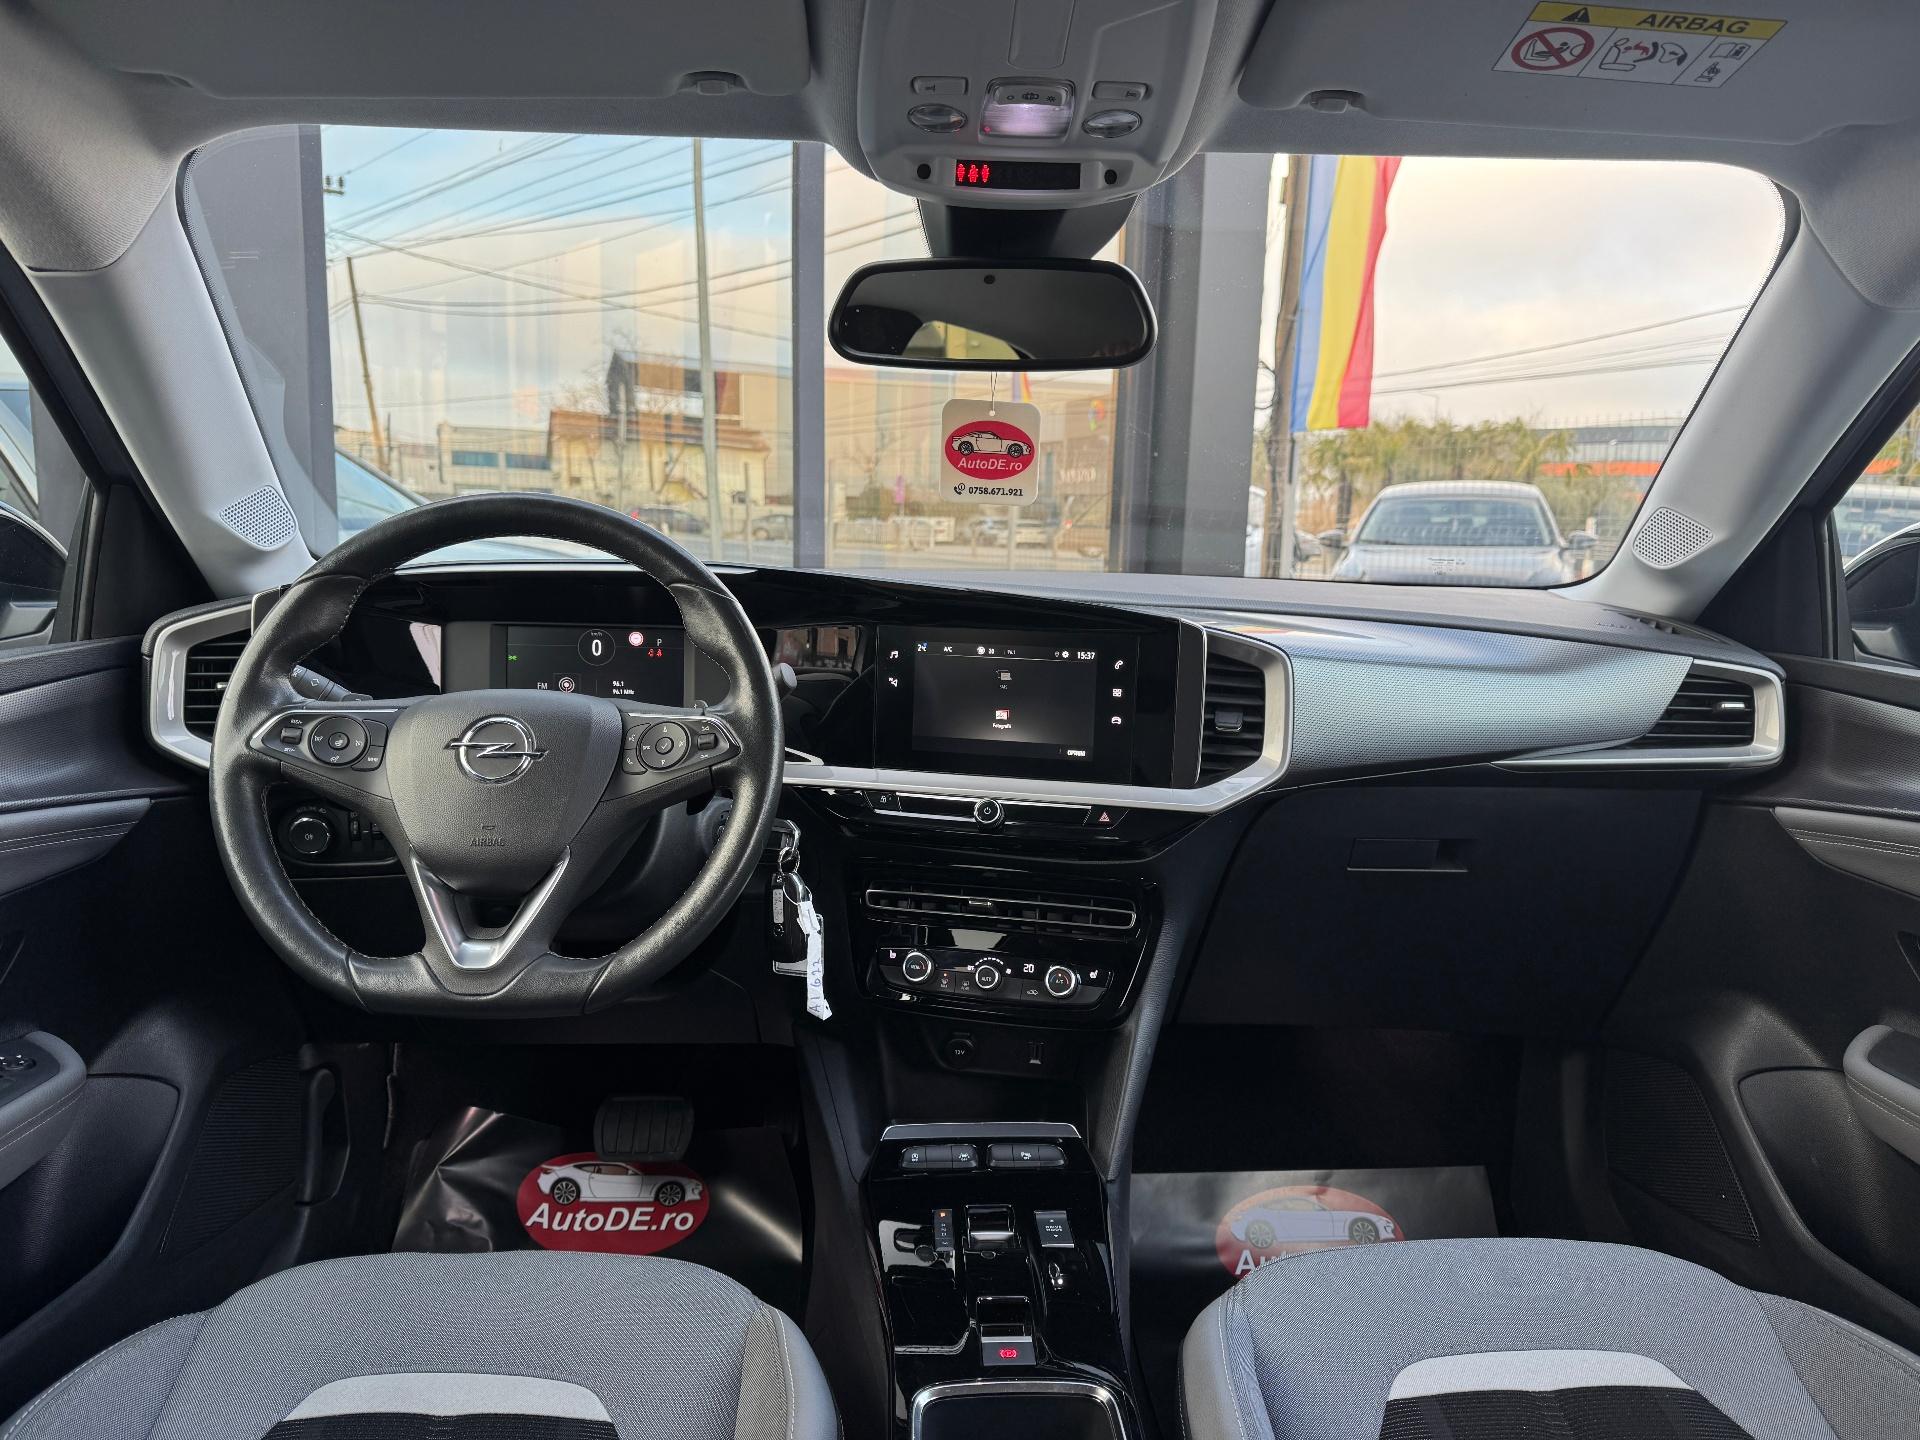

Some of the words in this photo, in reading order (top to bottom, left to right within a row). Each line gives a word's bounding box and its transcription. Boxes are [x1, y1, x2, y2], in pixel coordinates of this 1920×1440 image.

[1636, 13, 1751, 35] AIRBAG
[957, 457, 1023, 471] AutoDE.ro
[968, 486, 1024, 497] 0758.671.921
[592, 639, 602, 657] 0
[656, 638, 662, 647] P
[1077, 651, 1096, 660] 15:37
[537, 682, 548, 690] FM
[1023, 963, 1035, 973] 20
[526, 1202, 694, 1232] AutoDE.ro
